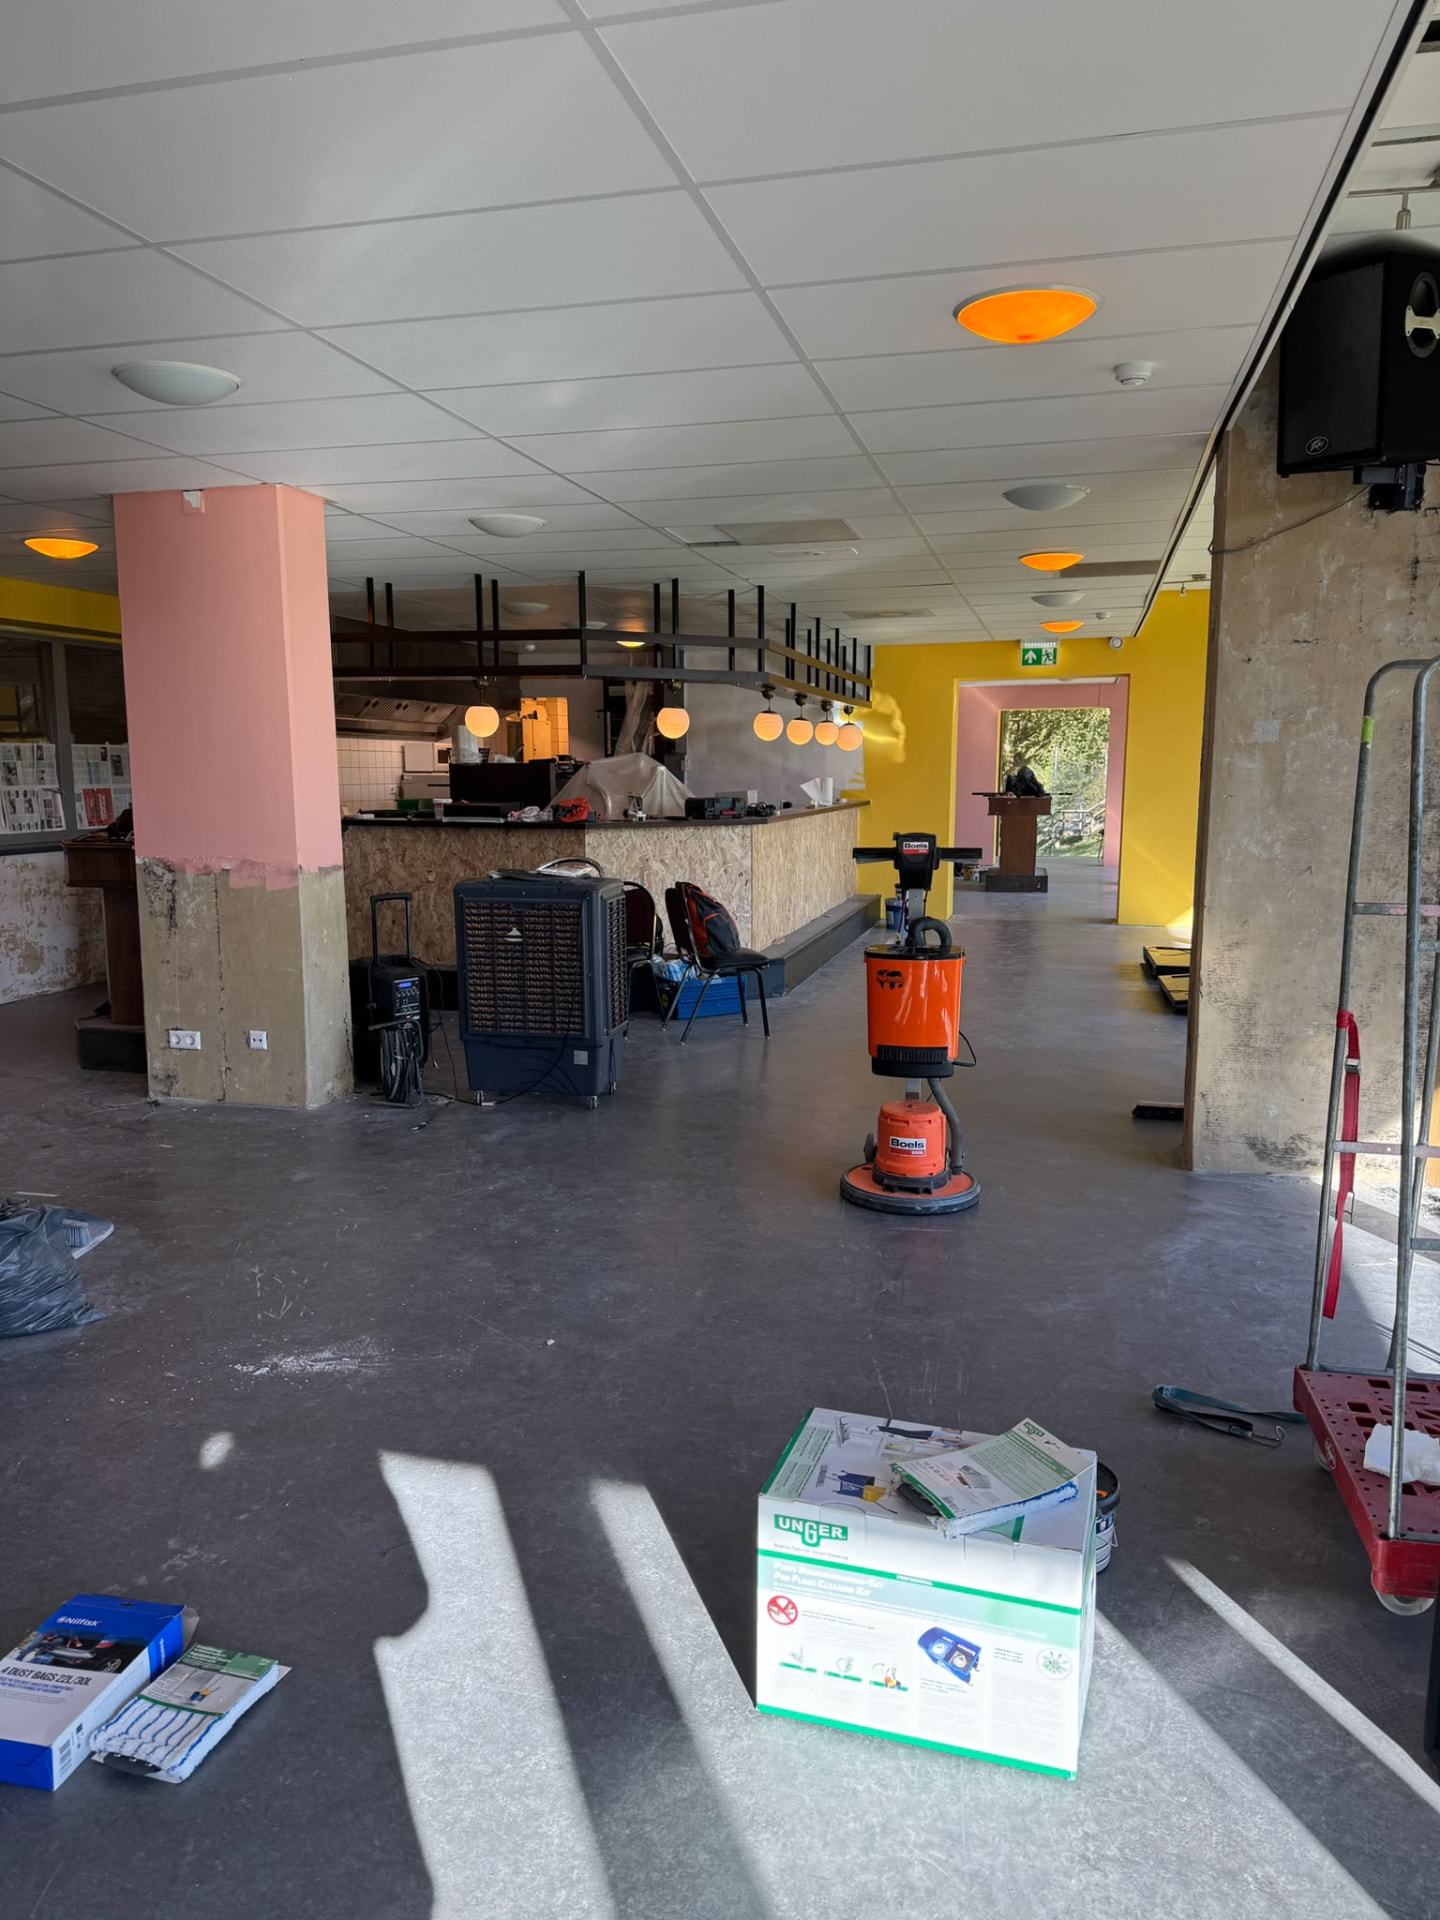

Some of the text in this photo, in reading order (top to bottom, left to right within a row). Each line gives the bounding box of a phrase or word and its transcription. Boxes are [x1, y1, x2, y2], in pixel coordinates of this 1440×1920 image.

[891, 1137, 925, 1149] Boels
[778, 1516, 844, 1544] UNGER
[65, 1617, 101, 1627] Nilfisk
[1, 1666, 10, 1674] 4
[7, 1667, 34, 1678] DUST
[31, 1670, 59, 1682] BAGS
